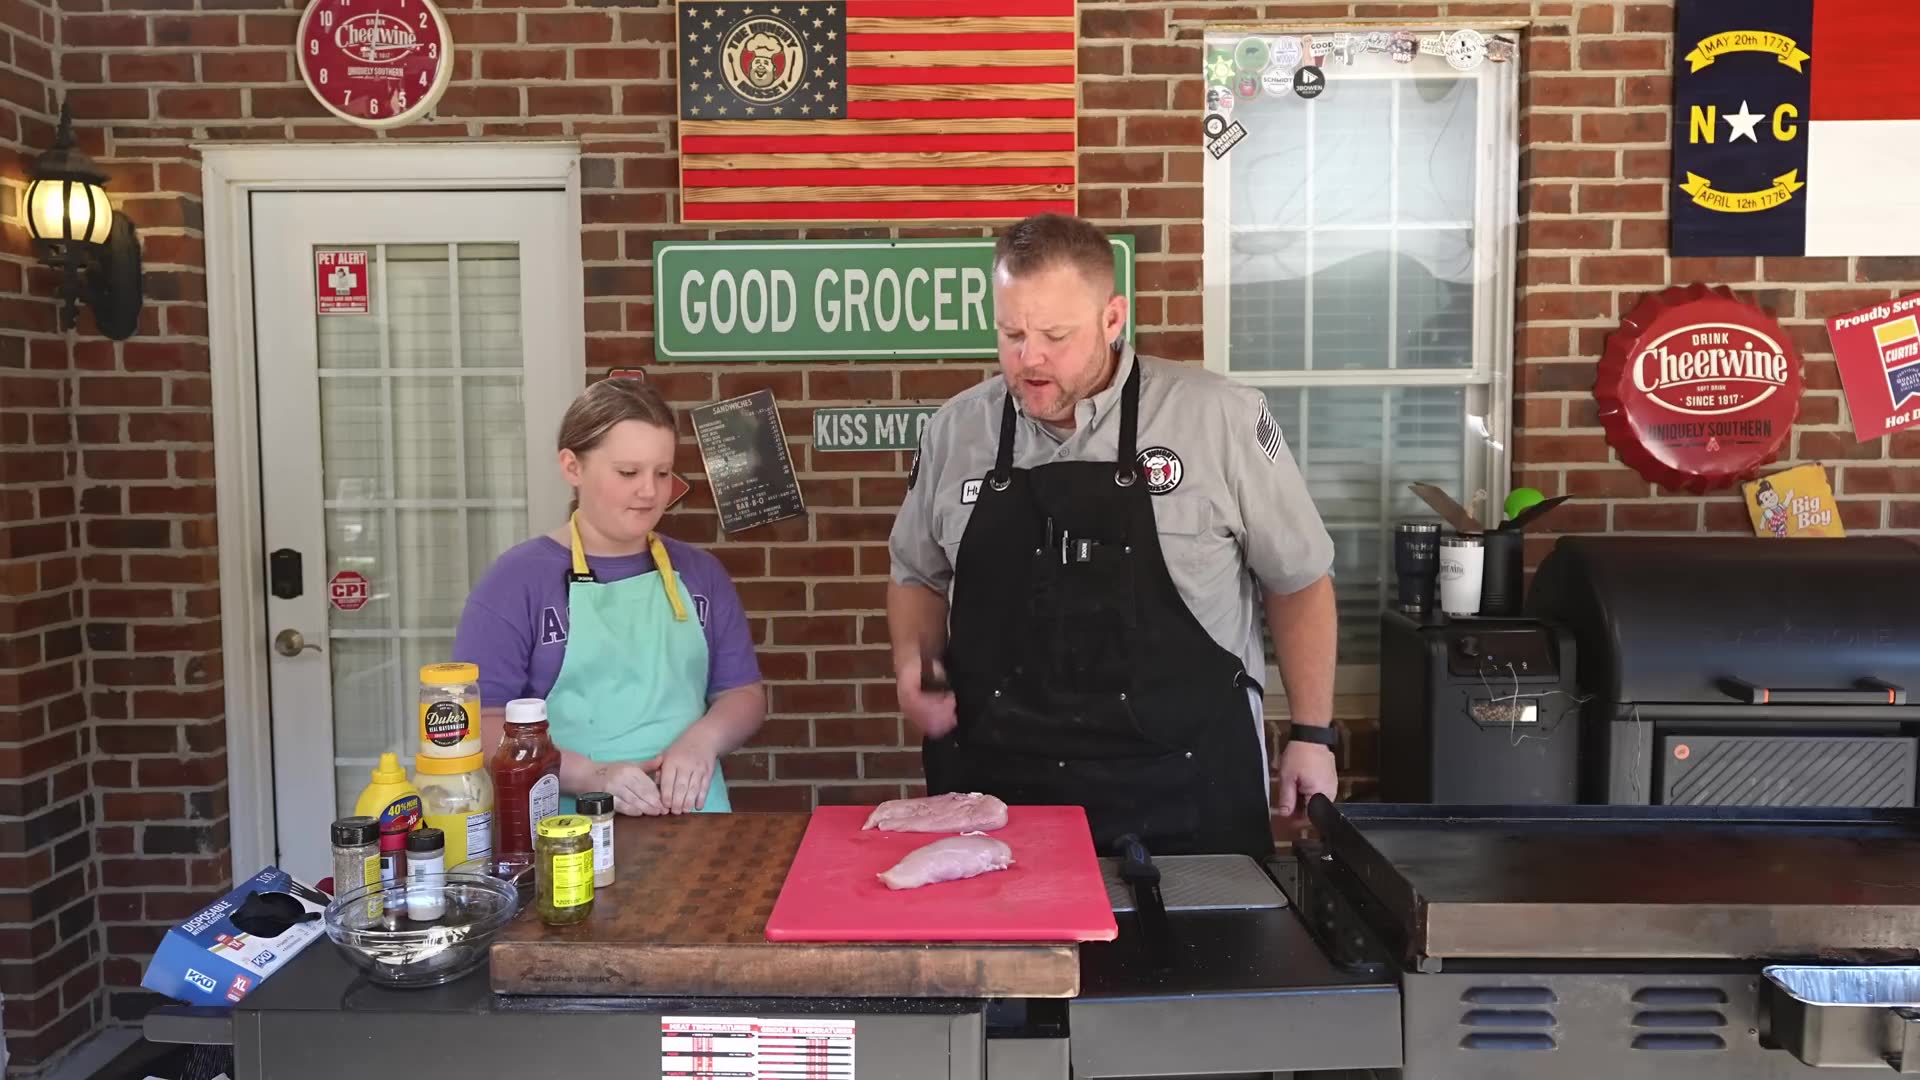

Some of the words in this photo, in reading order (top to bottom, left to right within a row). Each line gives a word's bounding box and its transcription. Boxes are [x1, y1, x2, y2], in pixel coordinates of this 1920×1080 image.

[319, 10, 333, 27] 10
[419, 12, 428, 29] 2
[310, 39, 319, 56] 9
[428, 42, 437, 59] 3
[1704, 34, 1730, 54] MAY
[1734, 34, 1759, 46] 20th
[1763, 35, 1791, 53] 1775
[319, 68, 329, 84] 8
[418, 71, 428, 87] 4
[343, 90, 352, 106] 7
[369, 98, 379, 115] 6
[398, 91, 407, 108] 5
[1688, 105, 1716, 144] N
[1772, 103, 1798, 142] C
[1698, 190, 1731, 209] APRIL
[1736, 198, 1758, 209] 12th
[1760, 190, 1786, 207] 1776
[319, 252, 336, 265] PET
[337, 252, 365, 265] ALERT
[679, 268, 798, 335] GOOD
[814, 266, 999, 334] GROCER
[1835, 306, 1891, 331] Proudly
[1691, 332, 1729, 347] DRINK
[1885, 341, 1919, 363] CURTIS
[1632, 340, 1788, 393] Cheerwine
[712, 398, 753, 416] SANDWICHES
[1685, 394, 1715, 407] SINCE
[1717, 393, 1739, 405] 1917
[1707, 419, 1772, 438] SOUTHERN
[1885, 411, 1911, 429] Hot
[816, 413, 868, 446] KISS
[875, 413, 910, 445] MY
[1792, 495, 1821, 515] Big
[1797, 509, 1832, 530] Boy
[332, 584, 366, 598] CPI
[426, 711, 467, 726] Duke's
[181, 900, 233, 932] DISPOSABLE
[253, 951, 274, 967] KKD
[187, 969, 214, 989] KKD
[233, 977, 247, 992] XL
